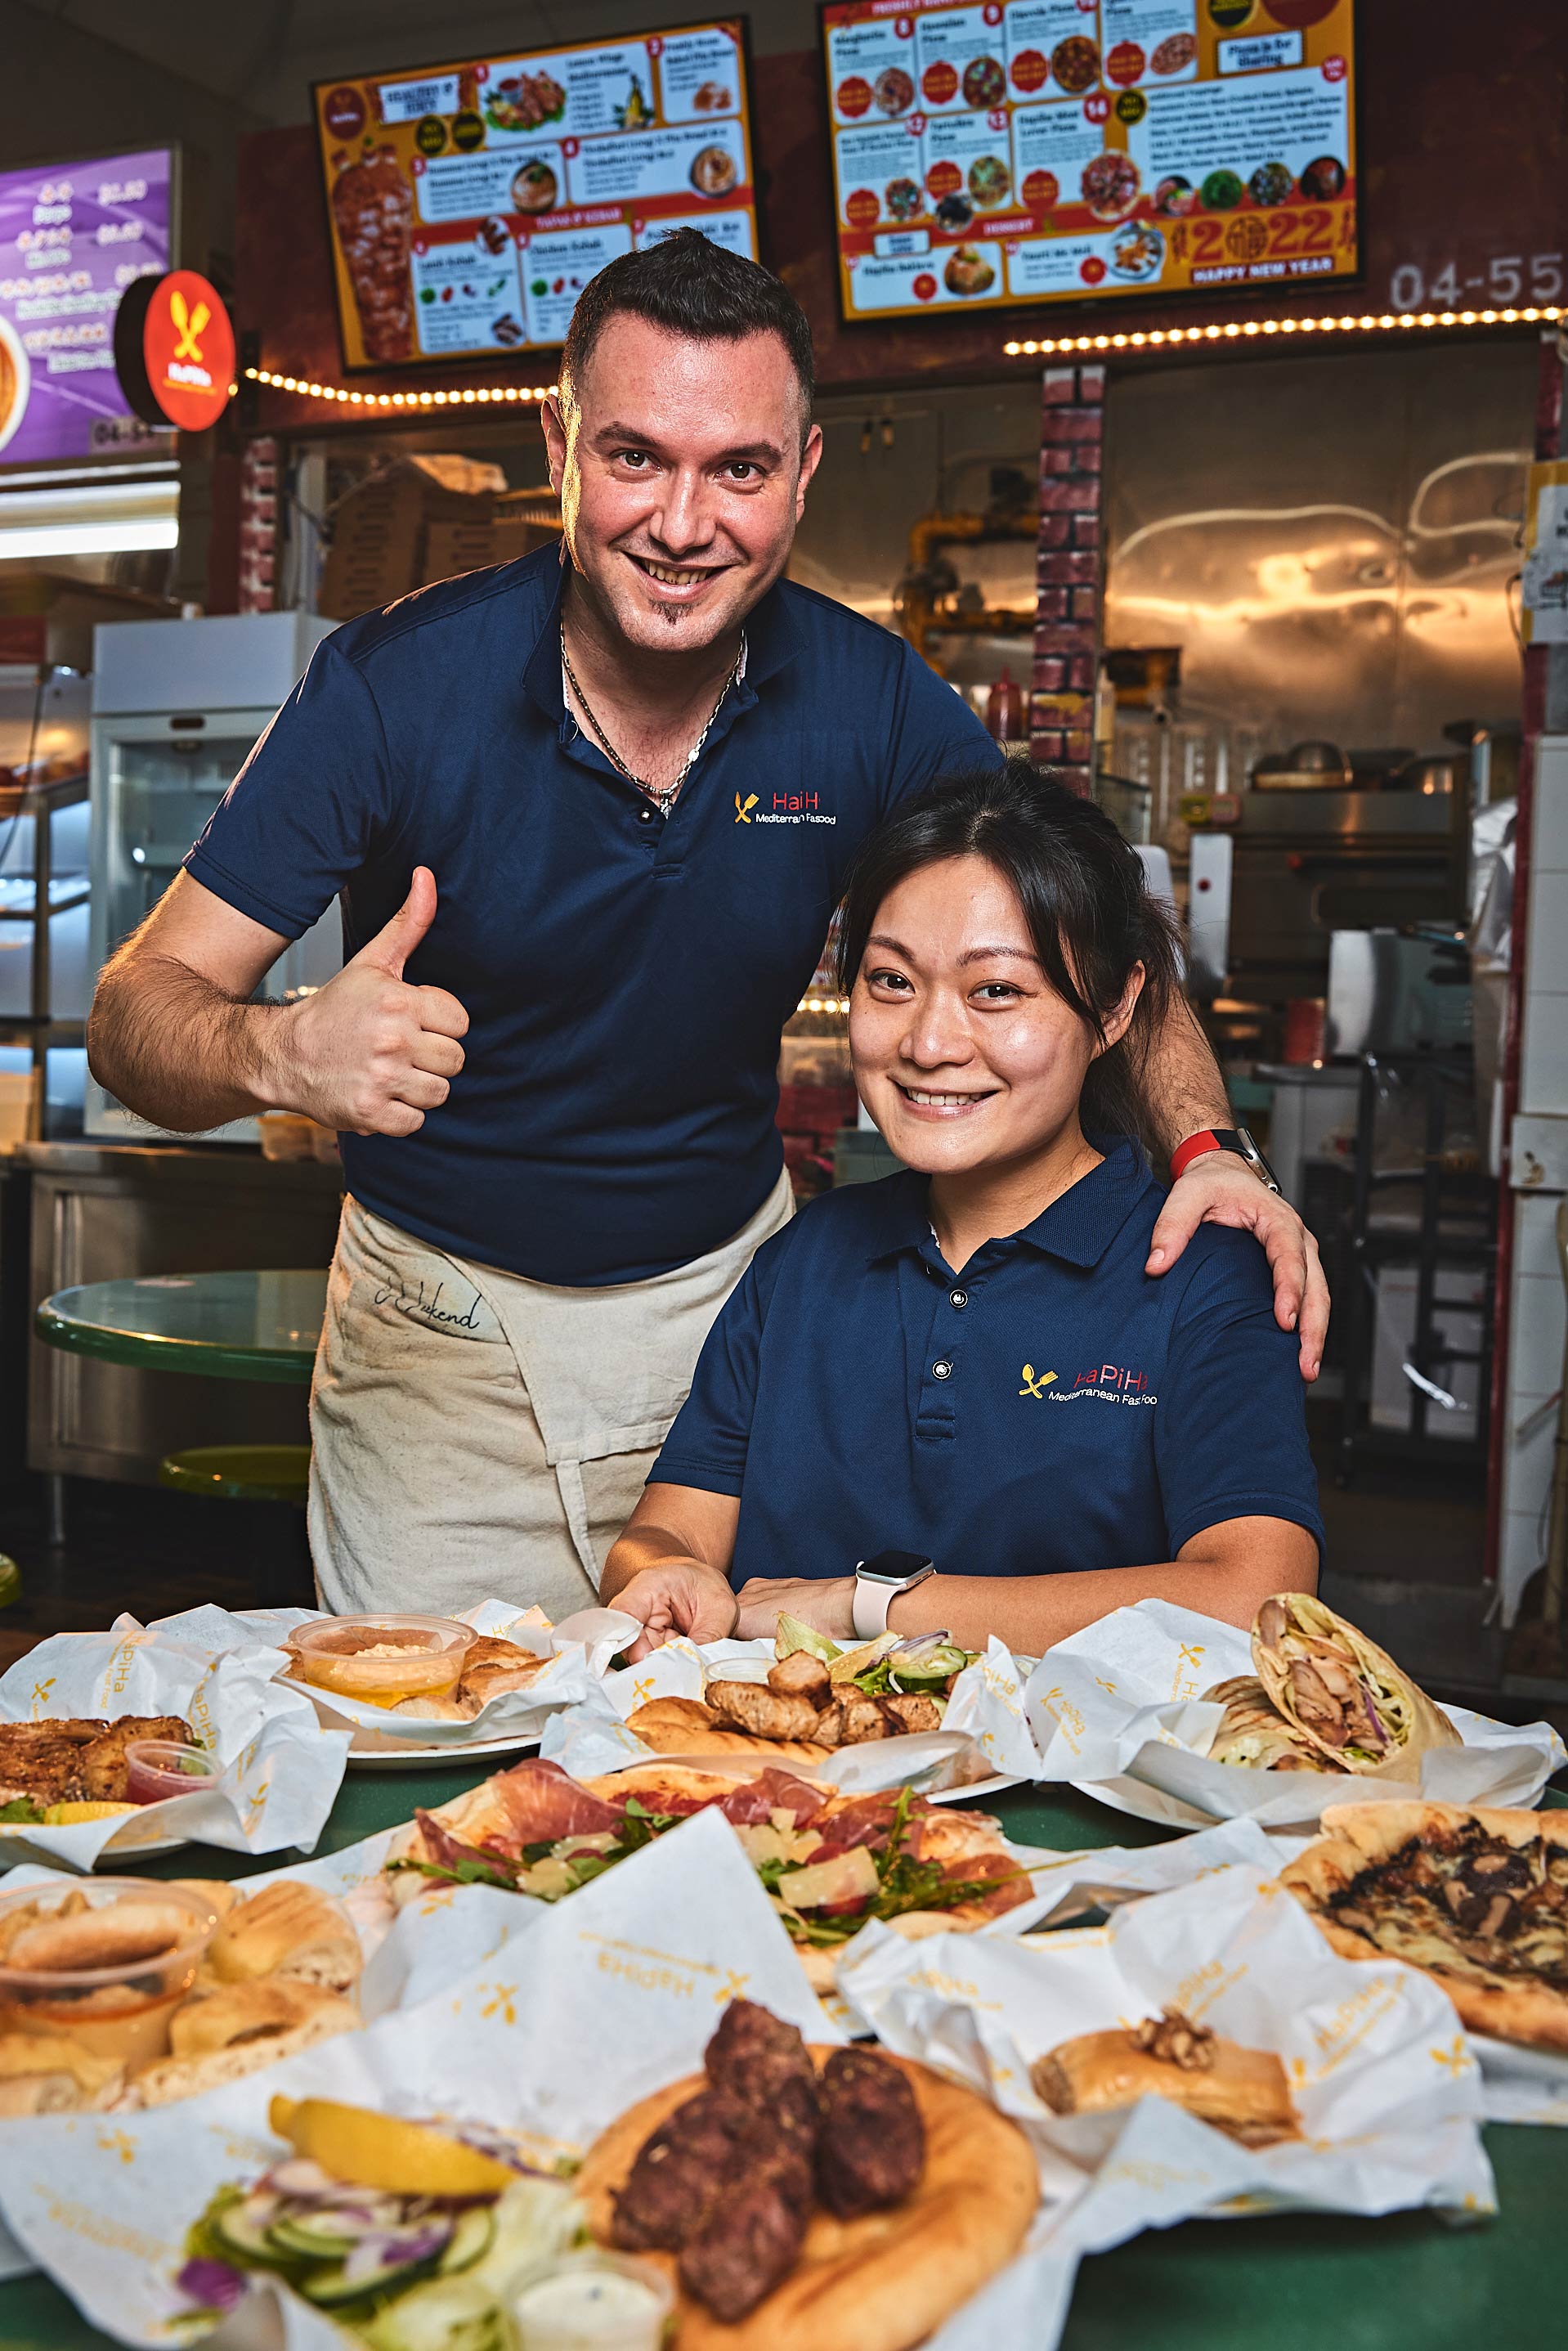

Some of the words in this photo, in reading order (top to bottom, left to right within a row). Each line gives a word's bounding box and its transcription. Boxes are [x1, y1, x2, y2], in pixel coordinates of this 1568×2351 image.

[1192, 266, 1246, 284] HAPPY
[1249, 262, 1286, 278] NEW
[1288, 257, 1334, 273] YEAR
[1391, 253, 1563, 312] 04-55
